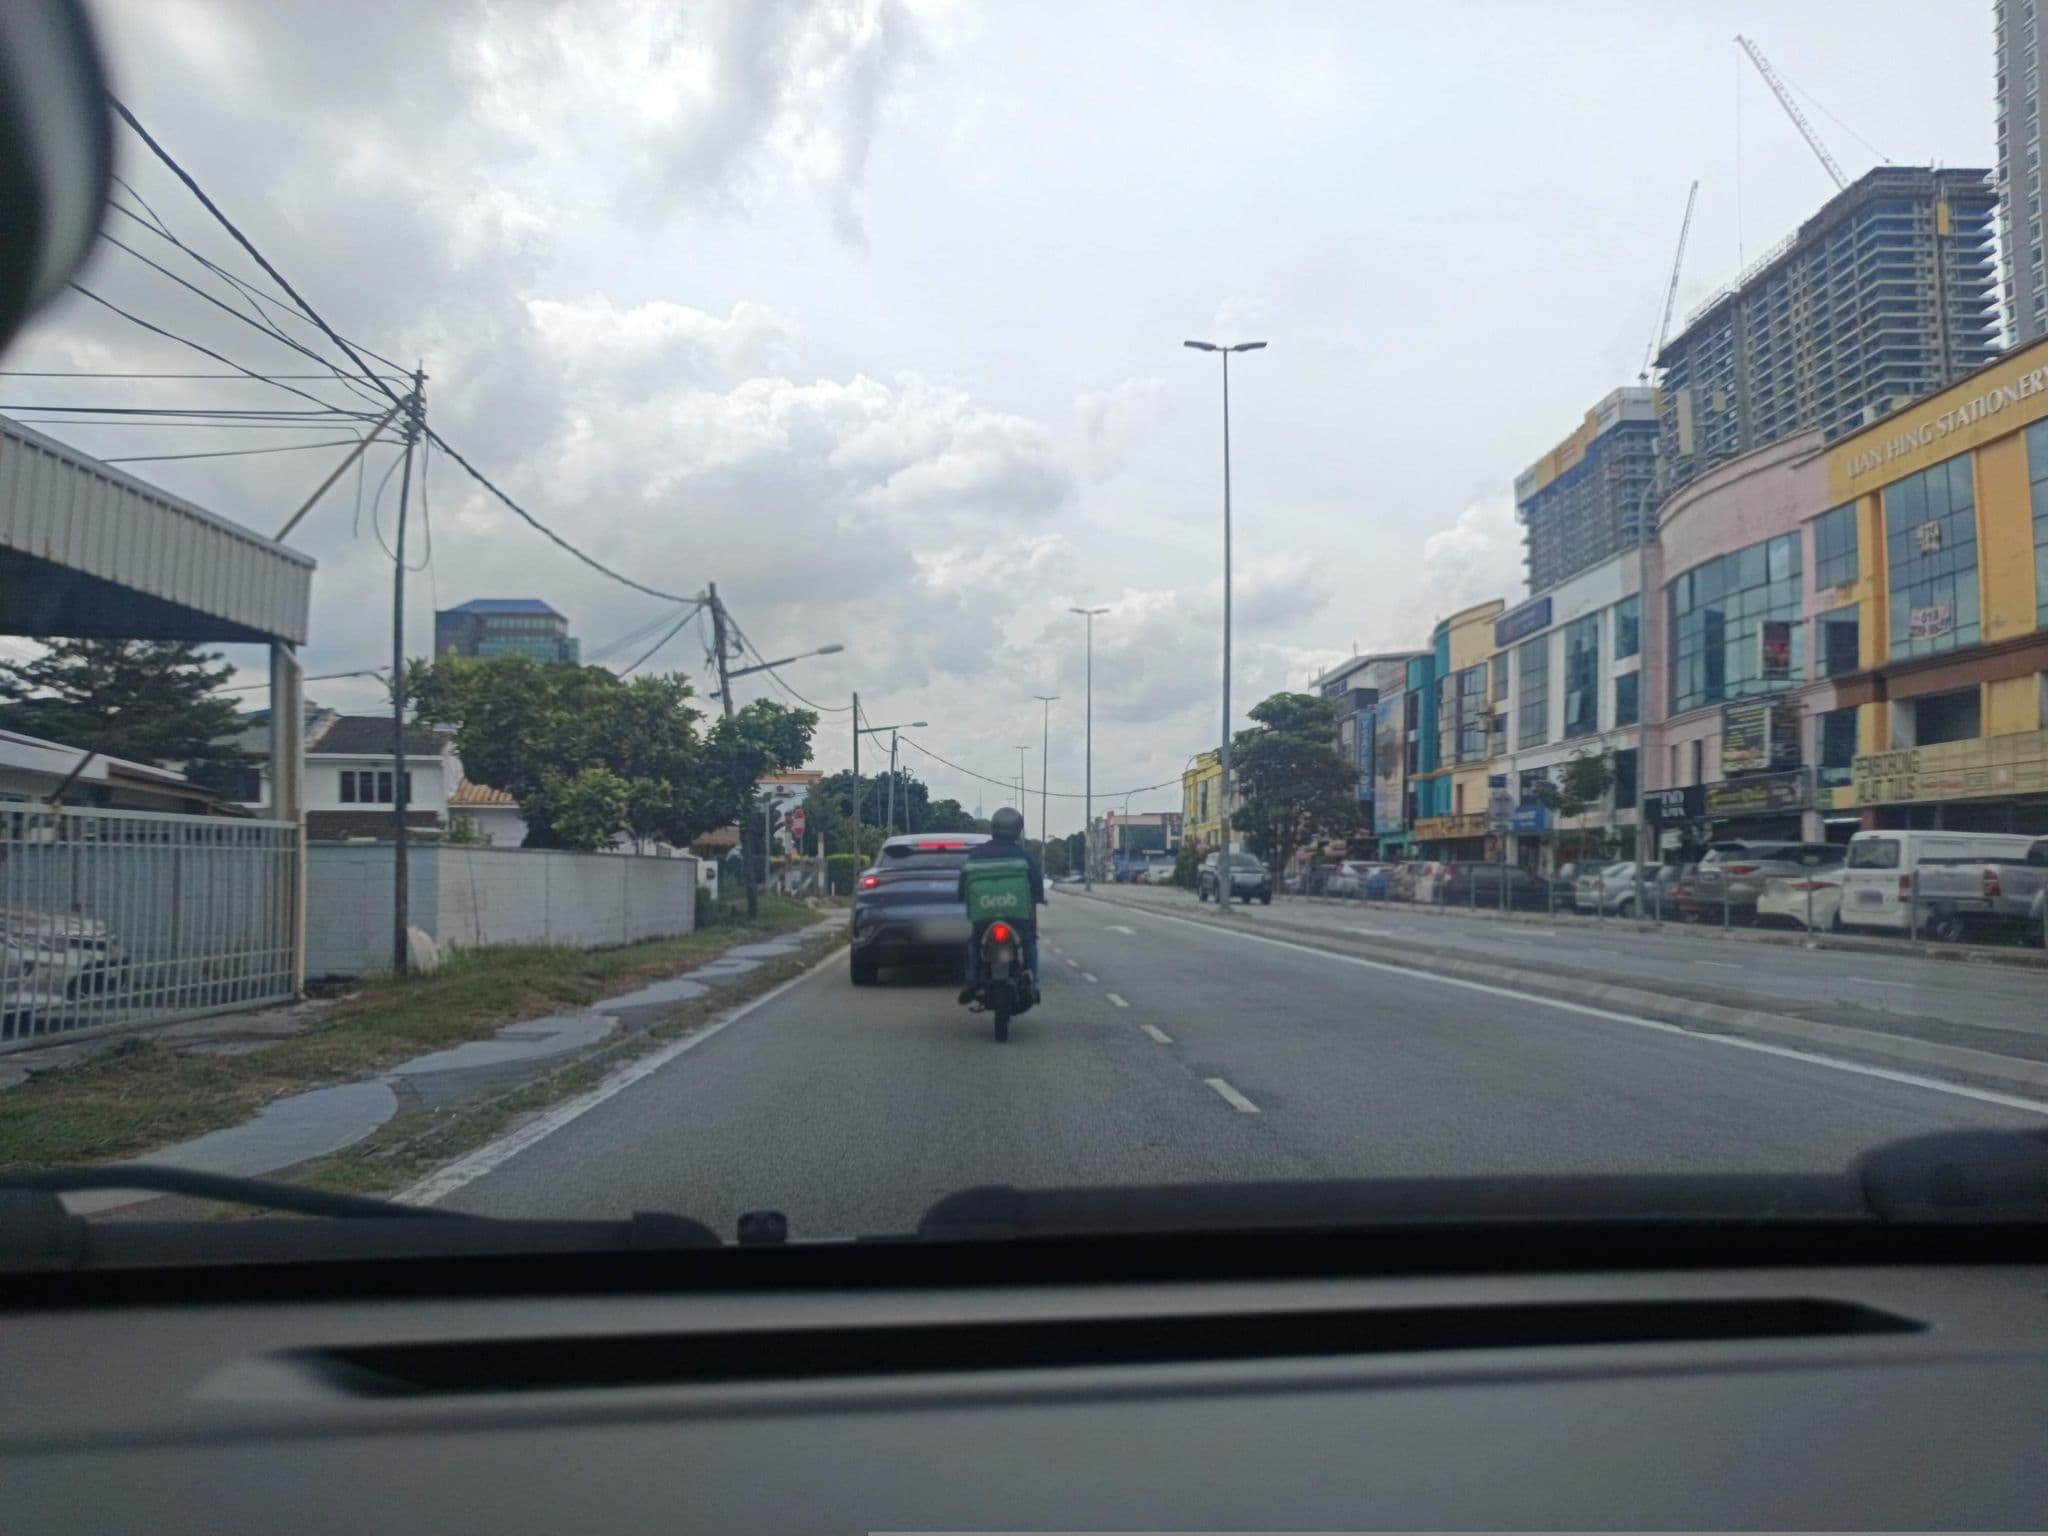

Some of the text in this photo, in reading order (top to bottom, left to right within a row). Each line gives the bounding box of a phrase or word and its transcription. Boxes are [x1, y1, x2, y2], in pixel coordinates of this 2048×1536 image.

[1847, 447, 1883, 477] LIAN
[1886, 422, 1933, 460] HING
[980, 892, 1017, 908] Grab
